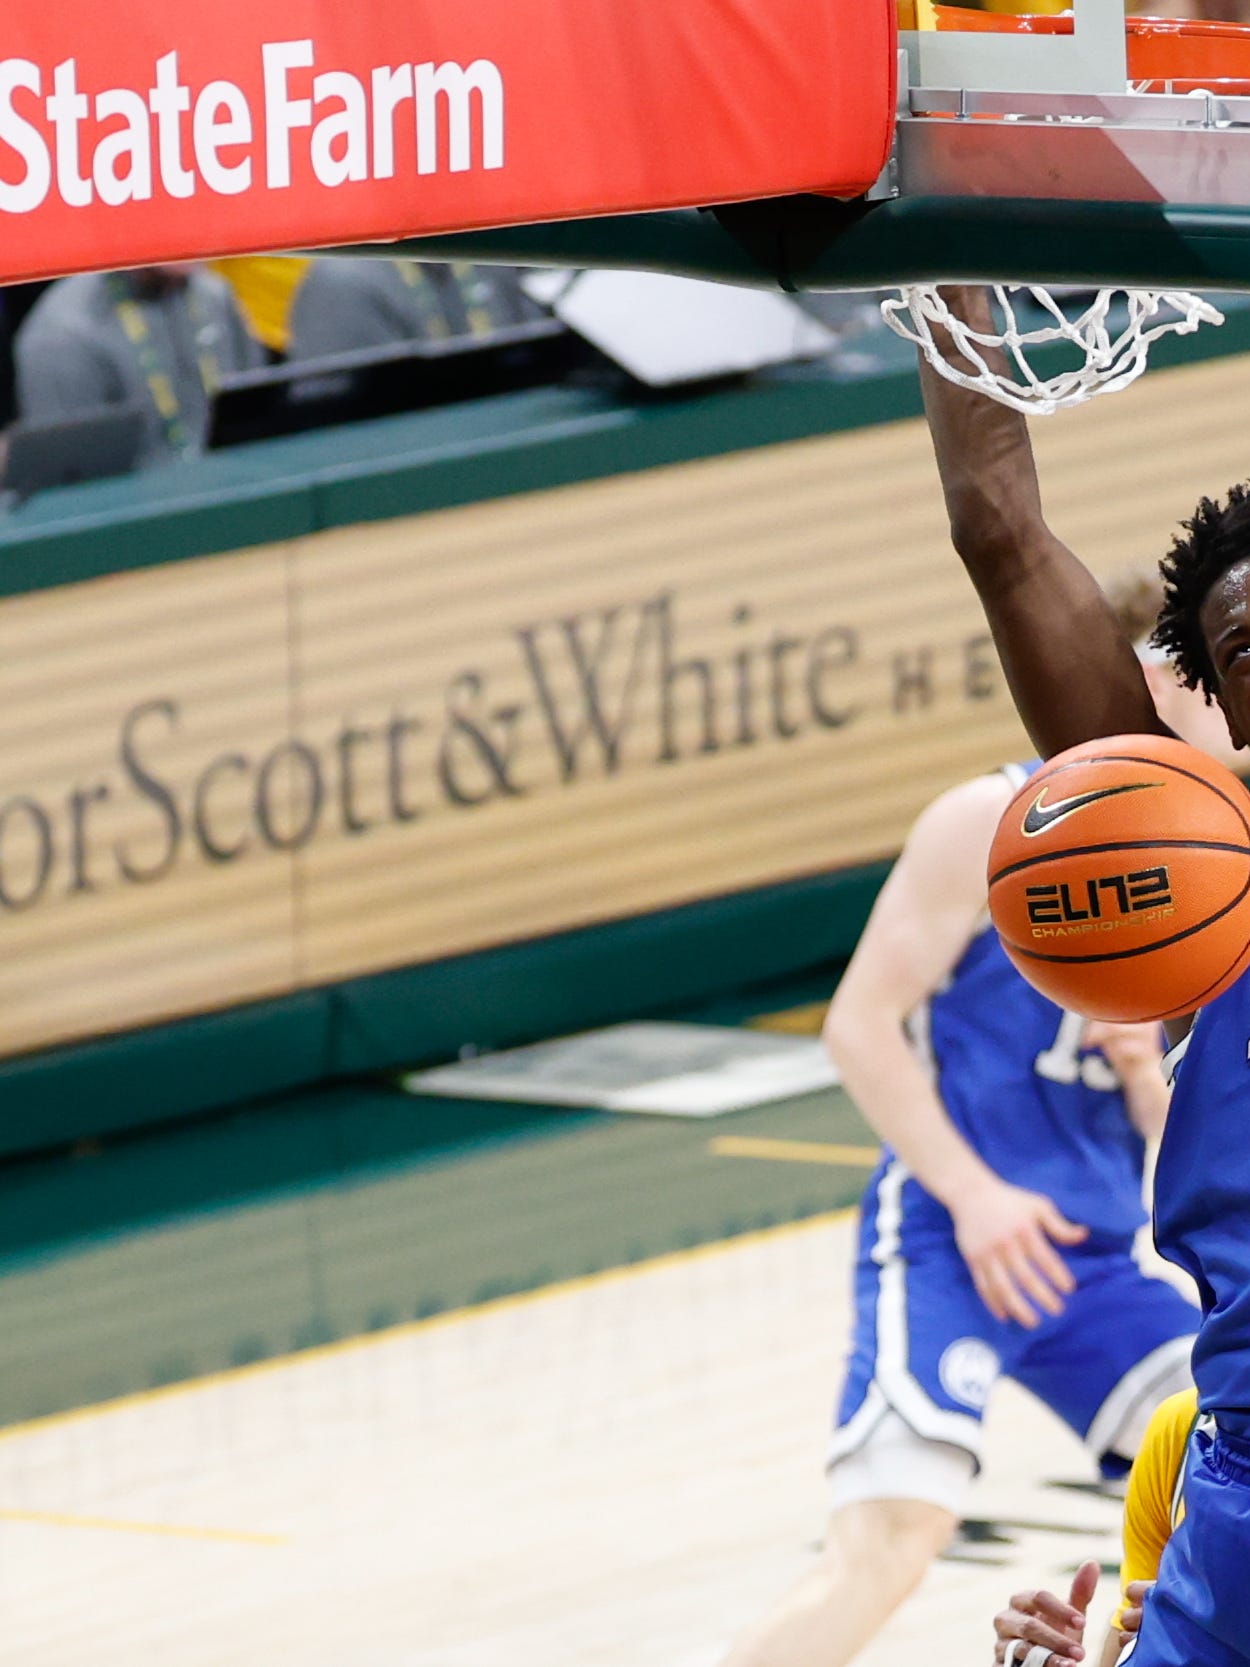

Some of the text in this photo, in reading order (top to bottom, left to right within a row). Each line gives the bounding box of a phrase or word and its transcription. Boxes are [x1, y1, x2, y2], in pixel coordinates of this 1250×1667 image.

[1026, 865, 1172, 924] ELITE
[1031, 908, 1177, 939] CHAMPIONSHIP
[1033, 1008, 1121, 1092] 1
